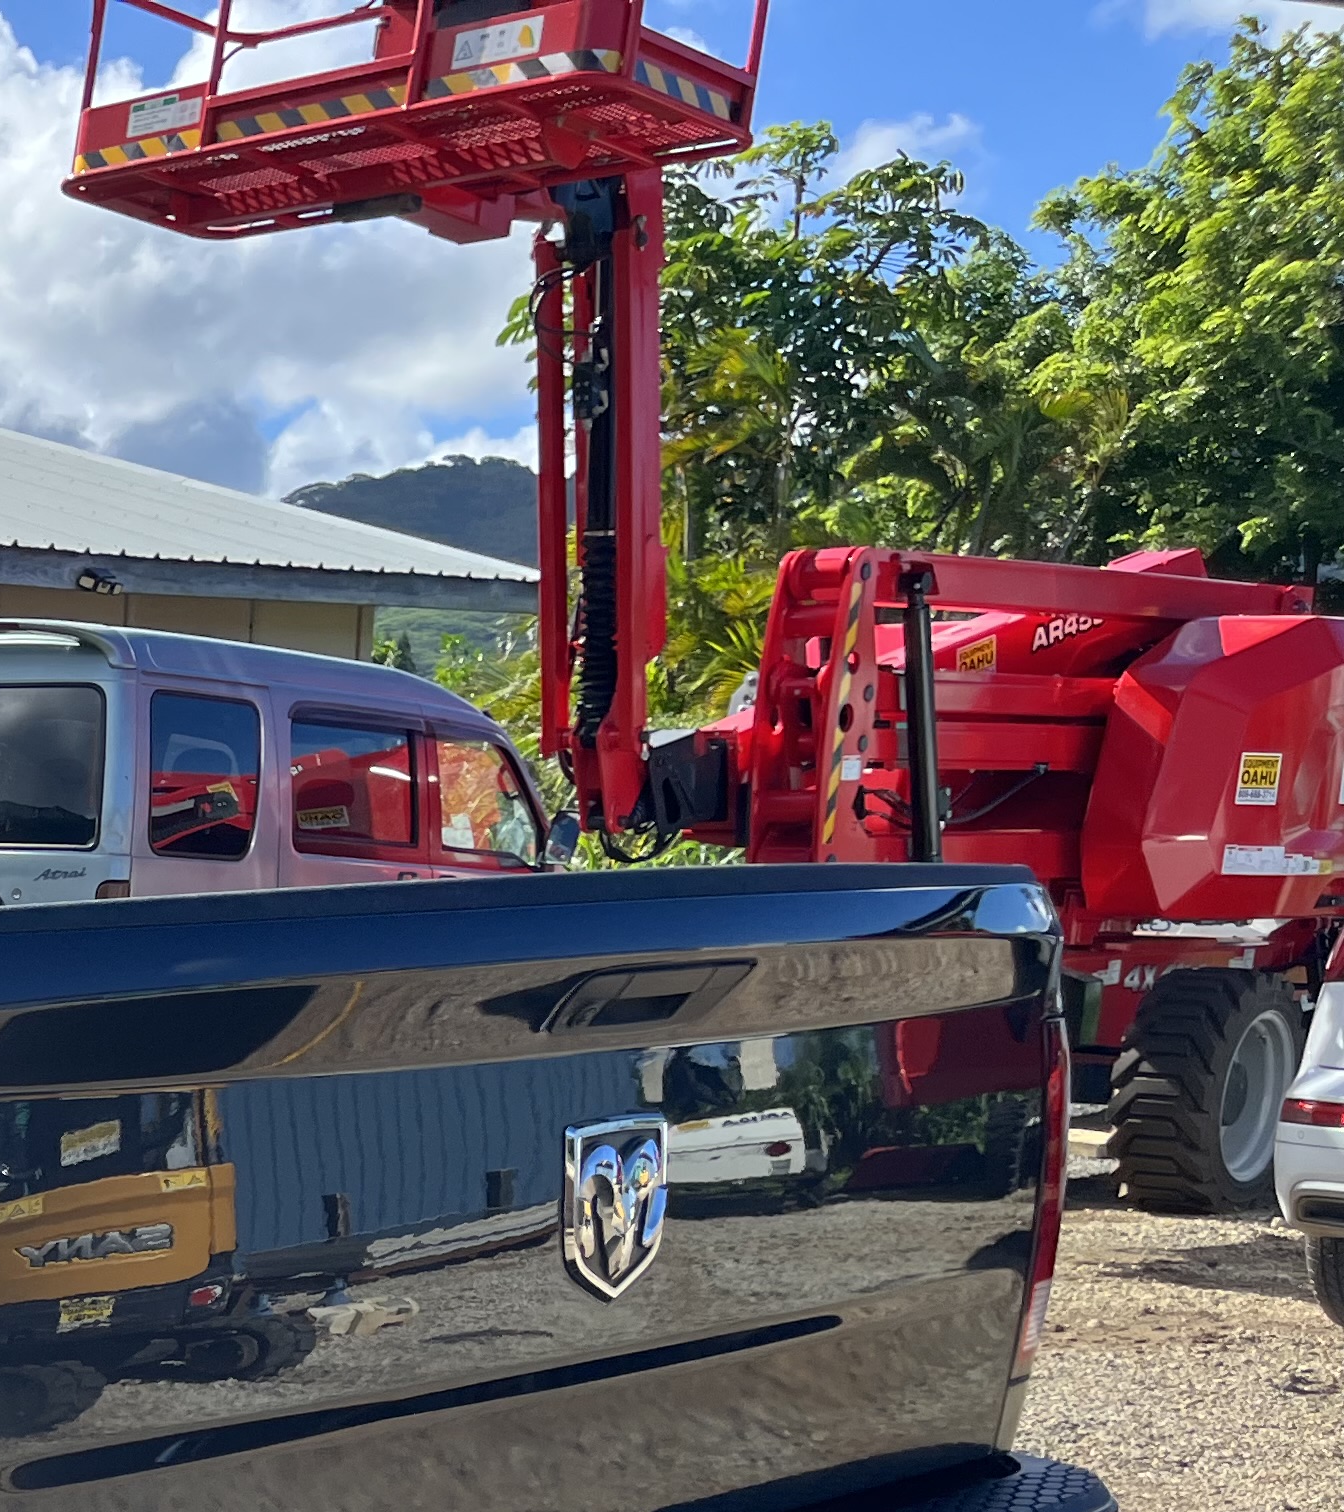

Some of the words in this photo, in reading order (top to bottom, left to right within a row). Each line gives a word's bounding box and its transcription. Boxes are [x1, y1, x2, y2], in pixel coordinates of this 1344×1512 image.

[959, 650, 994, 672] OAHU
[1241, 769, 1278, 785] OAHU
[33, 867, 87, 882] Atrai
